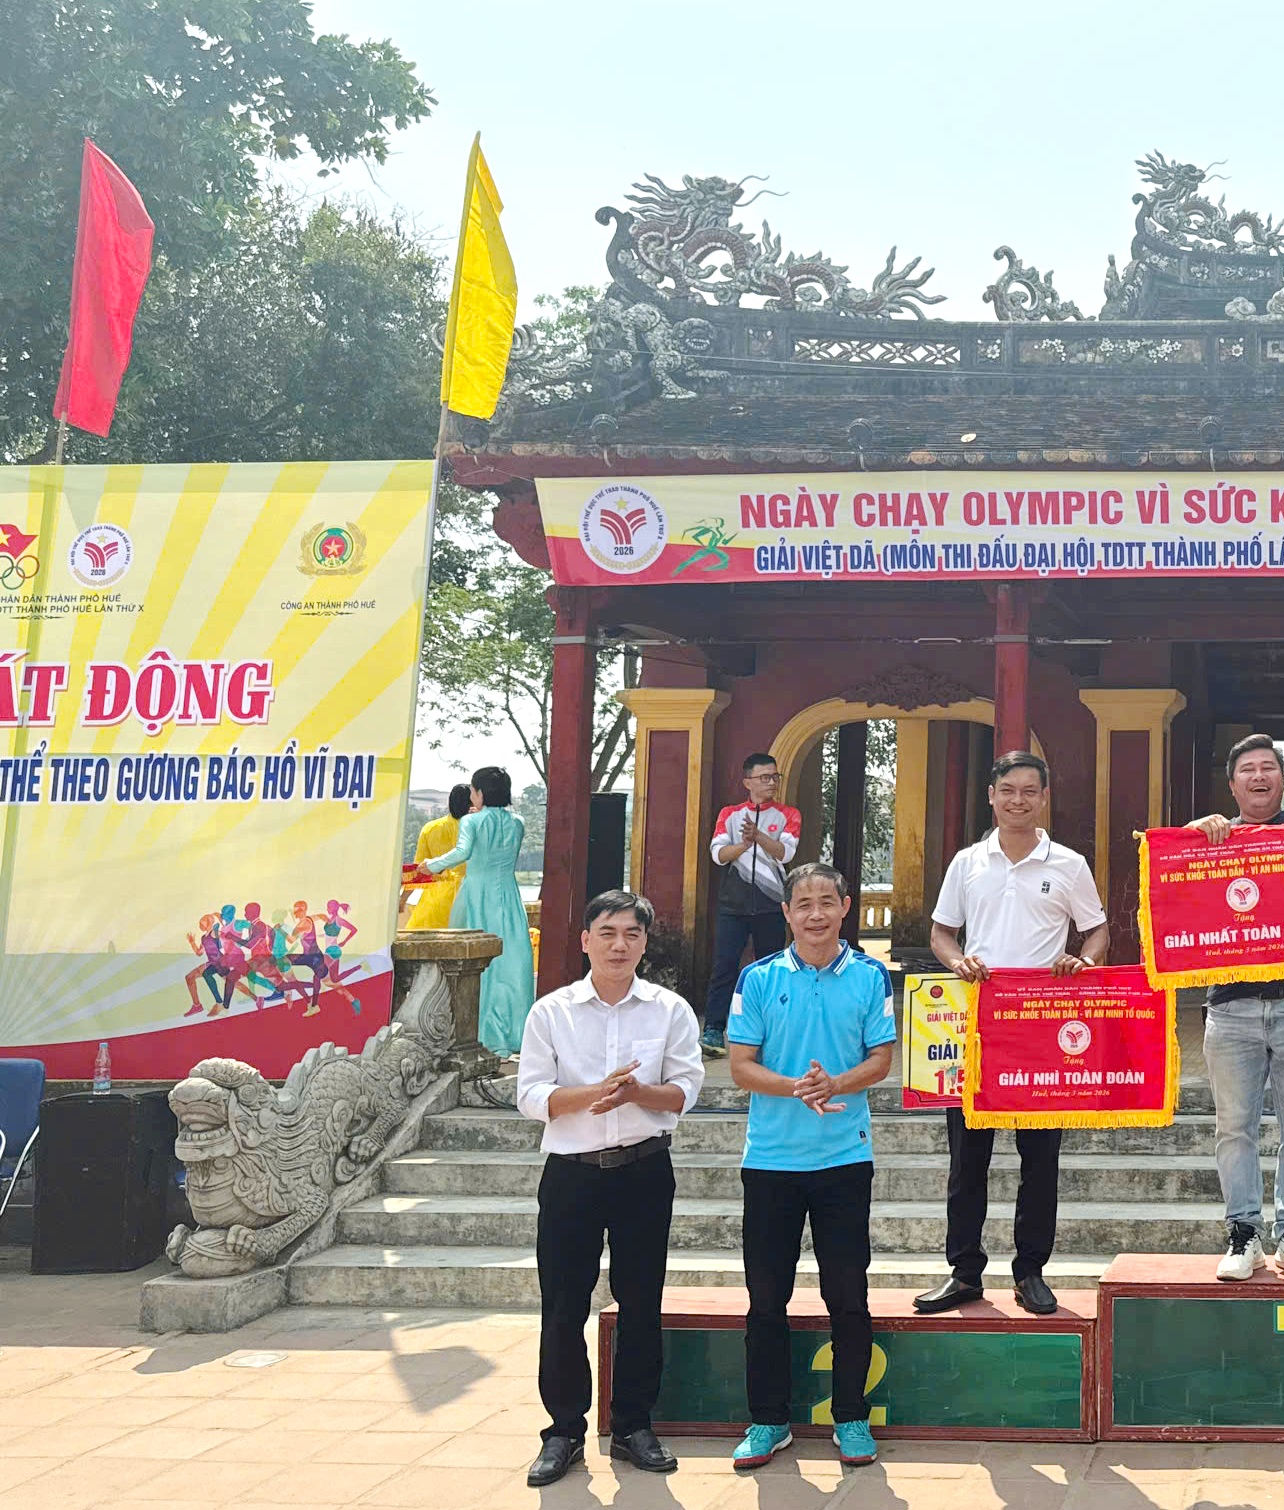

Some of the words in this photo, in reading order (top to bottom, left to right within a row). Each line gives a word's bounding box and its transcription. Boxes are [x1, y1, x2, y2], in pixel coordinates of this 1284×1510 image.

[740, 486, 840, 528] NGÀY
[853, 492, 949, 535] CHẠY
[963, 490, 1123, 526] OLYMPIC
[1136, 482, 1170, 524] VÌ
[1183, 482, 1256, 524] SỨC
[614, 547, 634, 556] 2026
[756, 537, 796, 571] GIẢI
[802, 539, 843, 576] VIỆT
[851, 540, 876, 570] DÃ
[882, 539, 936, 572] (MÔN
[942, 543, 971, 570] THI
[977, 534, 1017, 569] ĐẤU
[1023, 542, 1056, 573] ĐẠI
[1063, 537, 1095, 573] HỘI
[1101, 542, 1146, 567] TDTT
[1152, 536, 1216, 567] THÀNH
[1223, 532, 1263, 566] PHỐ
[22, 594, 42, 603] DÂN
[45, 594, 77, 603] THÀNH
[80, 593, 100, 603] PHỐ
[102, 593, 121, 602] HUẾ
[280, 601, 302, 610] CÔNG
[316, 600, 341, 609] THÀNH
[343, 600, 359, 609] PHỐ
[361, 599, 376, 608] HUẾ
[0, 606, 13, 614] TT
[16, 604, 47, 613] THÀNH
[50, 604, 70, 613] PHỐ
[73, 604, 92, 613] HUẾ
[116, 602, 137, 612] THỨ
[137, 604, 144, 612] X
[85, 651, 270, 731] ĐỘNG
[0, 740, 47, 801] THỂ
[51, 757, 110, 802] THEO
[116, 753, 200, 801] GƯƠNG
[206, 747, 256, 800] BÁC
[262, 740, 296, 800] HỒ
[304, 746, 329, 799] VĨ
[332, 755, 375, 809] ĐẠI
[1188, 860, 1216, 870] NGÀY
[1160, 872, 1168, 883] VÌ
[1208, 867, 1228, 879] TOÀN
[1251, 865, 1258, 876] VÌ
[1164, 930, 1195, 949] GIẢI
[1199, 926, 1239, 946] NHẤT
[1241, 923, 1281, 942] TOÀN
[1023, 999, 1051, 1009] NGÀY
[1083, 999, 1127, 1008] OLYMPIC
[927, 1012, 941, 1023] GIẢI
[943, 1012, 958, 1023] VIỆT
[993, 1010, 1001, 1020] VÌ
[1041, 1009, 1061, 1020] TOÀN
[1084, 1009, 1092, 1019] VÌ
[1093, 1009, 1105, 1018] AN
[1106, 1009, 1124, 1019] NINH
[928, 1038, 958, 1061] GIẢI
[999, 1069, 1030, 1086] GIẢI
[1033, 1069, 1060, 1086] NHÌ
[1063, 1069, 1103, 1085] TOÀN
[1106, 1069, 1145, 1085] ĐOÀN
